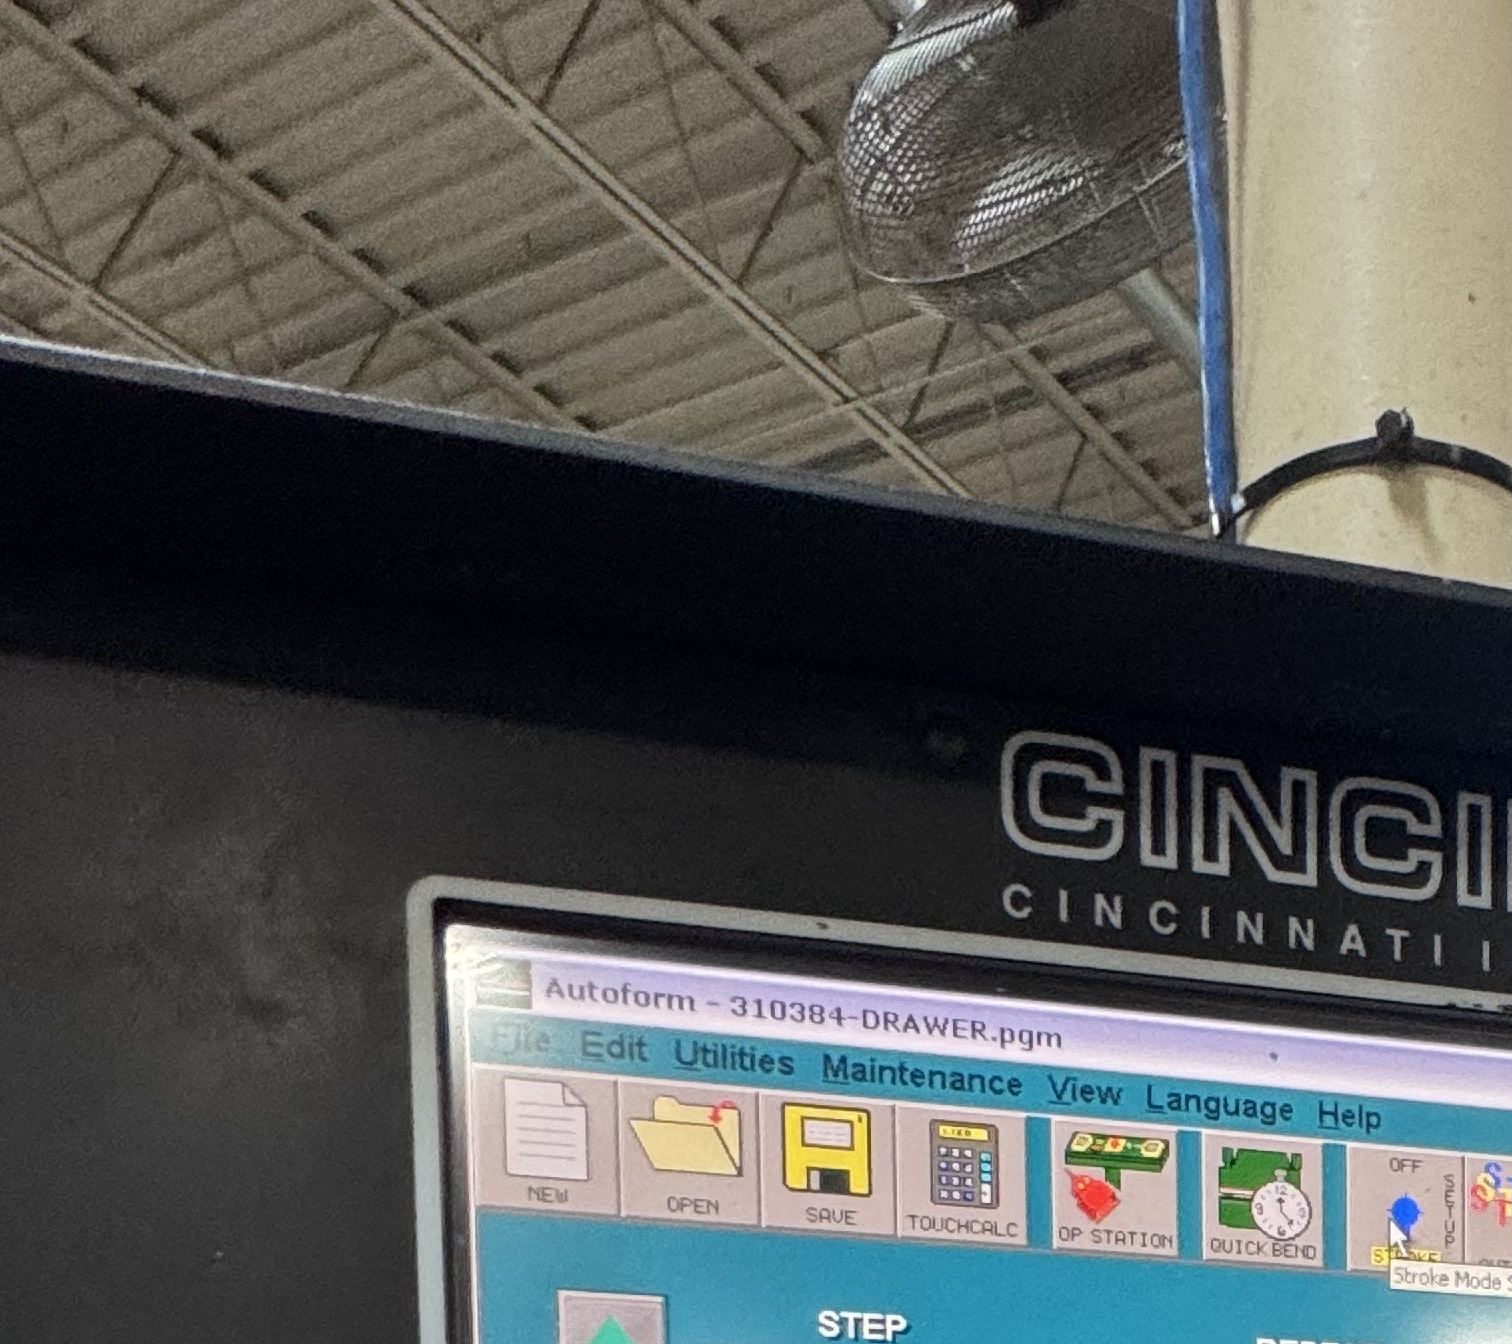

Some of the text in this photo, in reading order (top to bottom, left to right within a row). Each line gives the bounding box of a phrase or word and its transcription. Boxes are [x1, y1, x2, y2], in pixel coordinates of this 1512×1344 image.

[1003, 882, 1443, 967] CINCINNATI
[546, 978, 1062, 1051] Autoform 310384-DRAWER.pgm
[580, 1029, 648, 1062] Edit
[674, 1039, 795, 1075] Utilities
[822, 1053, 1022, 1098] Maintenance
[1047, 1075, 1122, 1106] View
[1146, 1084, 1294, 1126] Language
[1318, 1101, 1382, 1134] Help
[1389, 1157, 1425, 1174] OFF
[528, 1186, 569, 1203] NEW
[667, 1196, 719, 1216] OPEN
[806, 1207, 857, 1226] SAVE
[1443, 1174, 1456, 1249] SETUP
[907, 1213, 1018, 1238] TOUCHCALC
[1059, 1226, 1174, 1249] OP STATION
[1210, 1237, 1317, 1260] QUICK BEND
[1393, 1266, 1450, 1288] Stroke
[1454, 1270, 1501, 1290] Mode
[818, 1311, 908, 1341] STEP
